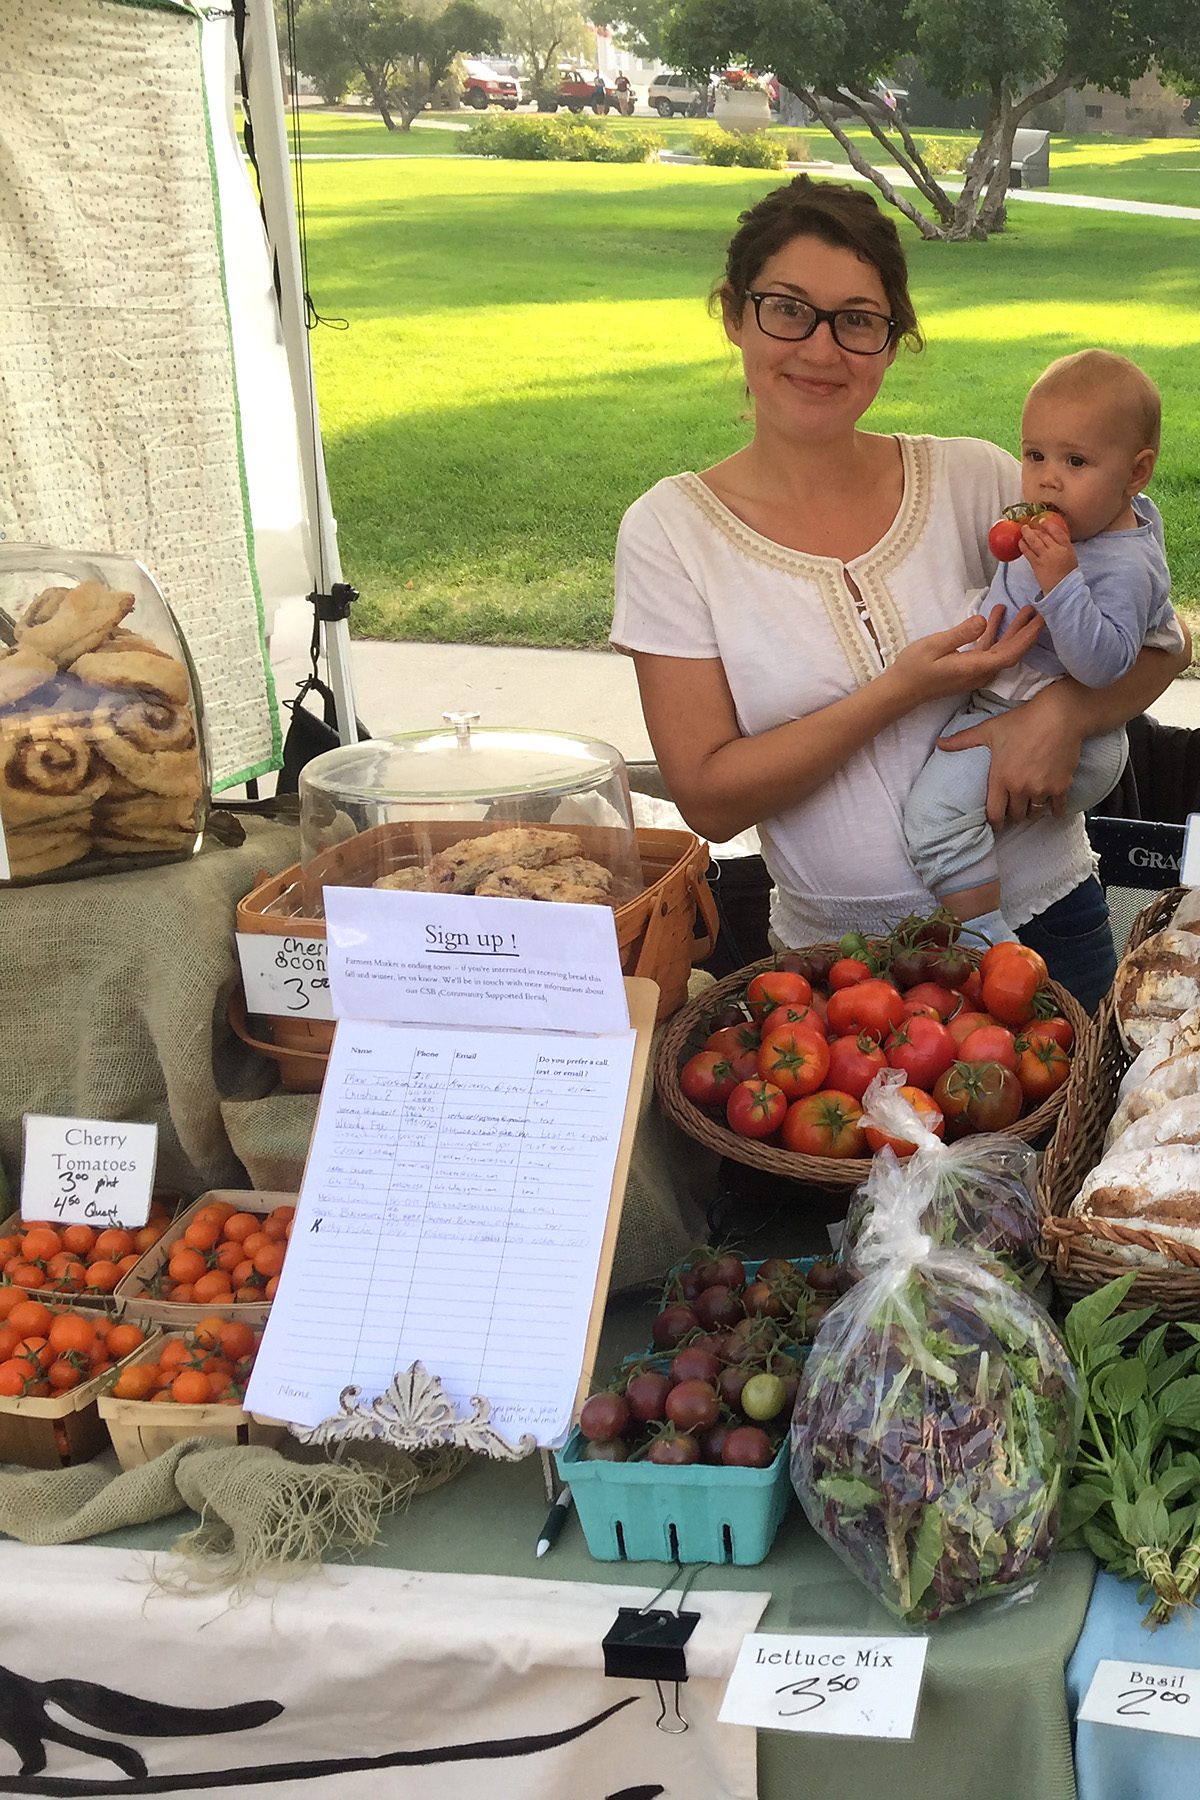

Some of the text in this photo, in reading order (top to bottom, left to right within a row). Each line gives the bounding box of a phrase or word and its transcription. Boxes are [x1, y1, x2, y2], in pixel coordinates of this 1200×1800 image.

[425, 924, 470, 950] Sign
[476, 933, 504, 952] up
[345, 957, 373, 966] Farmers
[374, 958, 399, 968] Market
[408, 960, 432, 971] ending
[468, 966, 490, 975] you're
[492, 966, 527, 975] interested
[537, 969, 568, 980] receiving
[568, 972, 588, 981] bread
[588, 974, 602, 982] this
[344, 970, 356, 978] fall
[371, 974, 396, 982] winter,
[442, 976, 462, 984] We'll
[482, 979, 504, 987] touch
[544, 982, 583, 994] information
[584, 986, 604, 995] about
[420, 988, 437, 996] CSB
[485, 991, 524, 1002] Supported
[351, 1046, 372, 1055] Name
[416, 1050, 439, 1058] Phone
[456, 1052, 477, 1060] Email
[552, 1058, 565, 1066] you
[566, 1058, 588, 1066] prefer
[65, 1128, 128, 1150] Cherry
[52, 1153, 137, 1172] Tomatoes
[94, 1174, 120, 1194] pint
[84, 1200, 118, 1219] Quart
[278, 1384, 311, 1400] Name
[755, 1648, 893, 1668] Lettuce Mix
[1130, 1671, 1186, 1688] Basil
